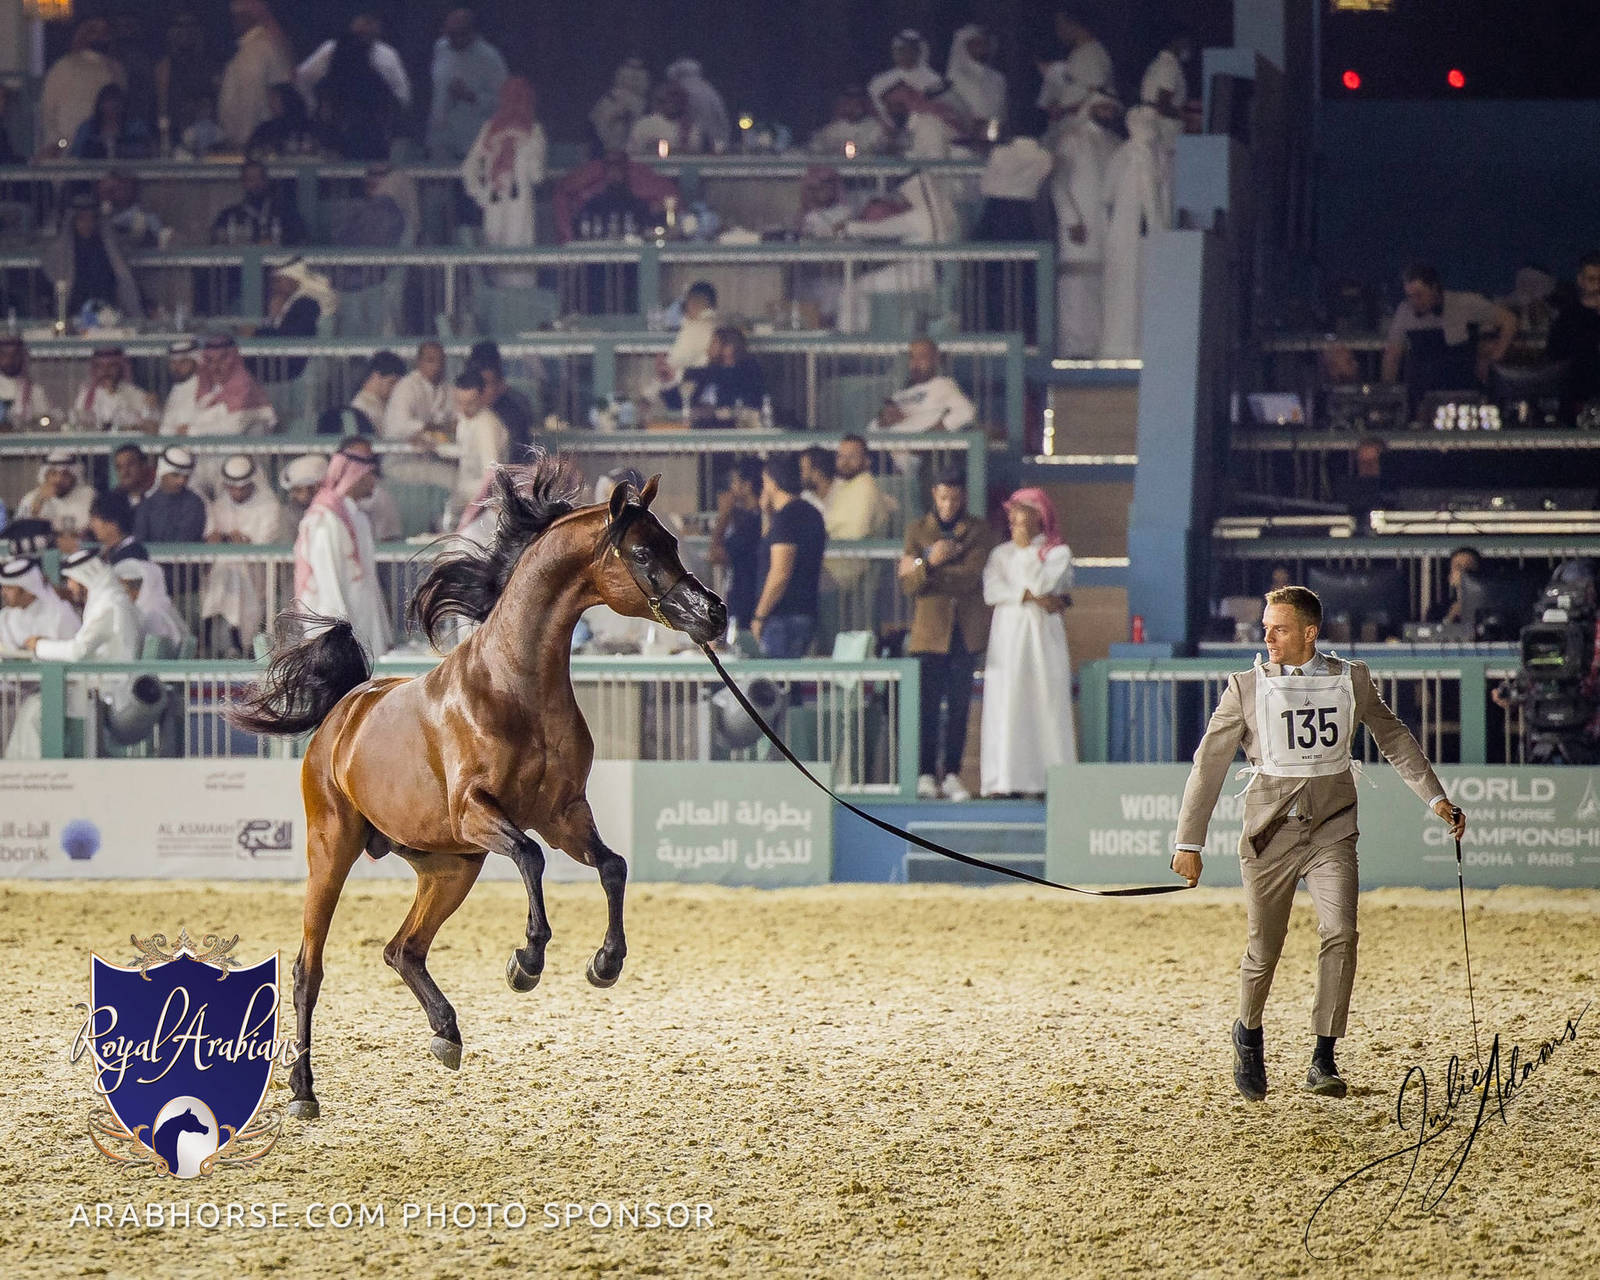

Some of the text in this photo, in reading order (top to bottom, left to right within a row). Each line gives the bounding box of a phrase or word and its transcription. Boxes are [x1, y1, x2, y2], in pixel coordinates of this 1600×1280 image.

[1281, 707, 1338, 749] 135
[656, 801, 812, 831] بطولة العالم
[1121, 795, 1180, 820] WORL
[1502, 809, 1556, 821] HORSE
[656, 838, 812, 870] للخيل العربية
[1089, 830, 1162, 855] HORSE
[1465, 852, 1575, 866] DOHA PARIS
